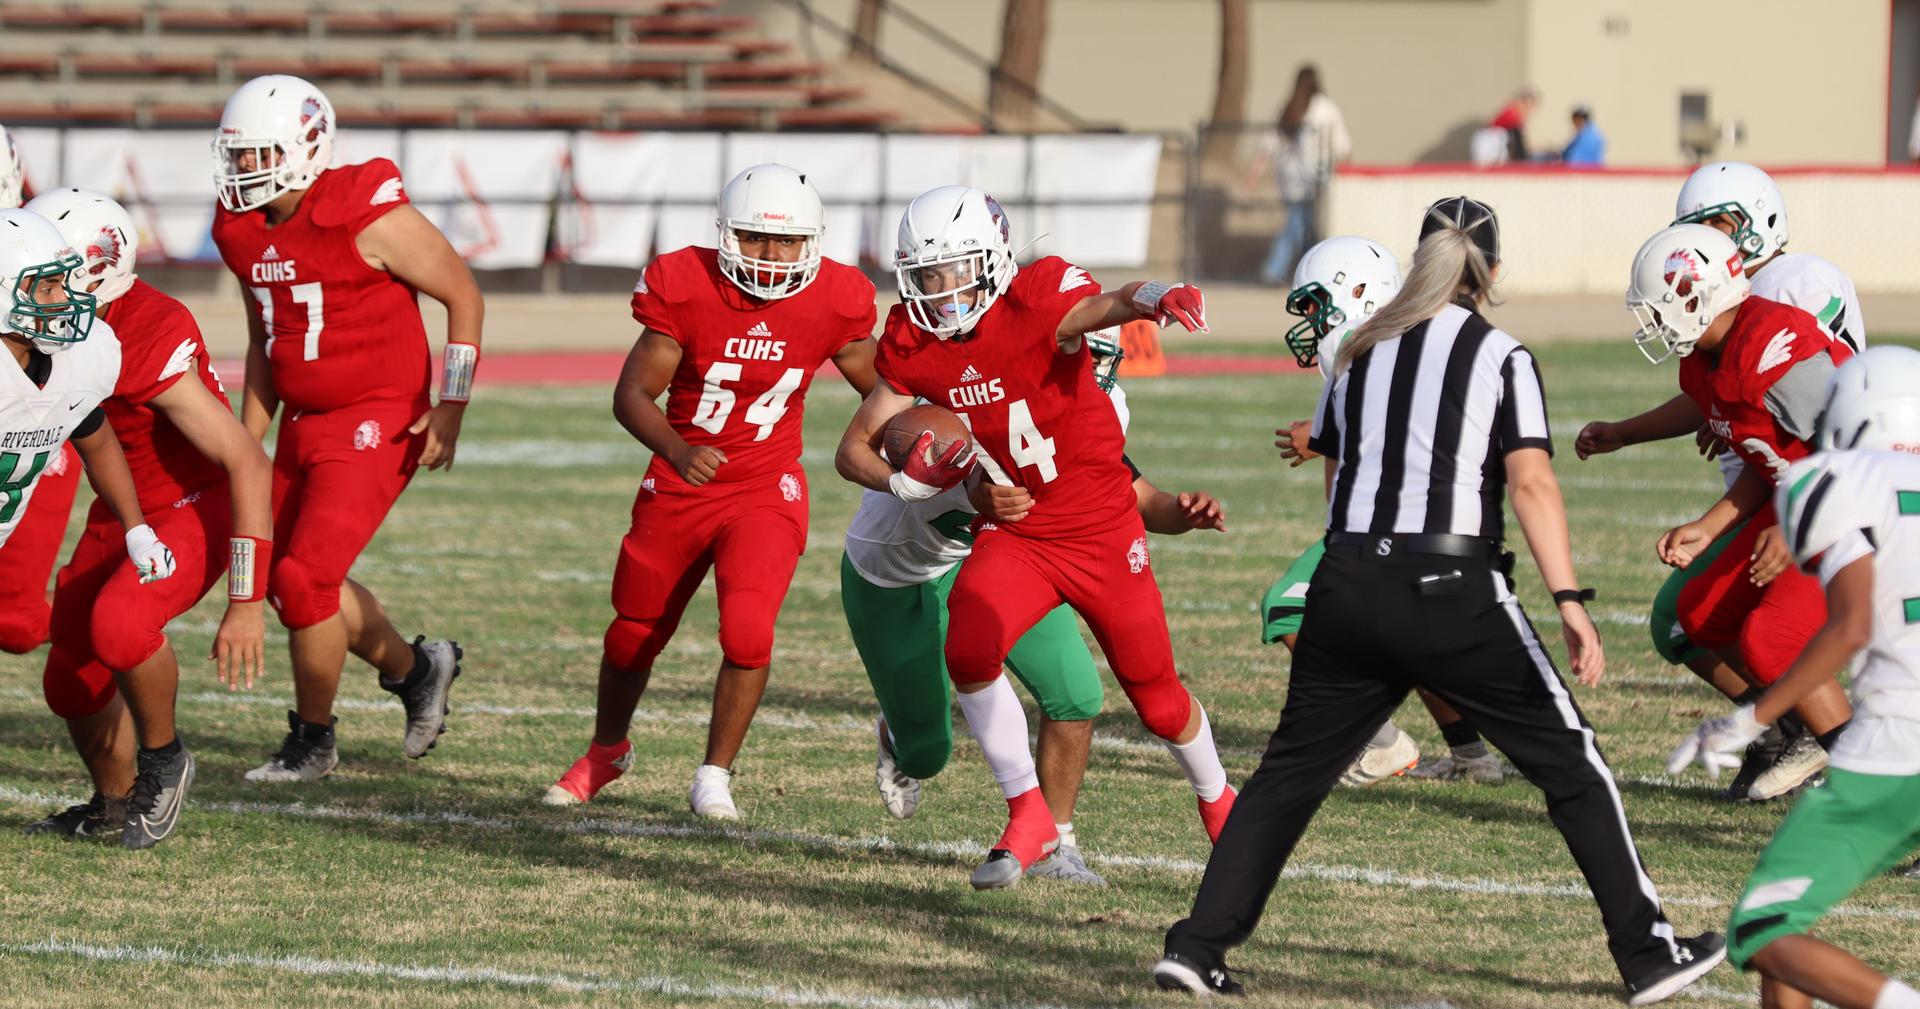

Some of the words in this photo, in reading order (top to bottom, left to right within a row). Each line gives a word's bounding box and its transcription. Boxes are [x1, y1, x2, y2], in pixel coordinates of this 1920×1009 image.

[251, 260, 297, 283] CUHS
[724, 337, 787, 361] CUHS
[691, 361, 805, 442] 64
[948, 378, 1006, 408] CUHS
[1, 426, 63, 448] RIVERDALE
[954, 398, 1059, 488] 14
[1375, 537, 1393, 556] S
